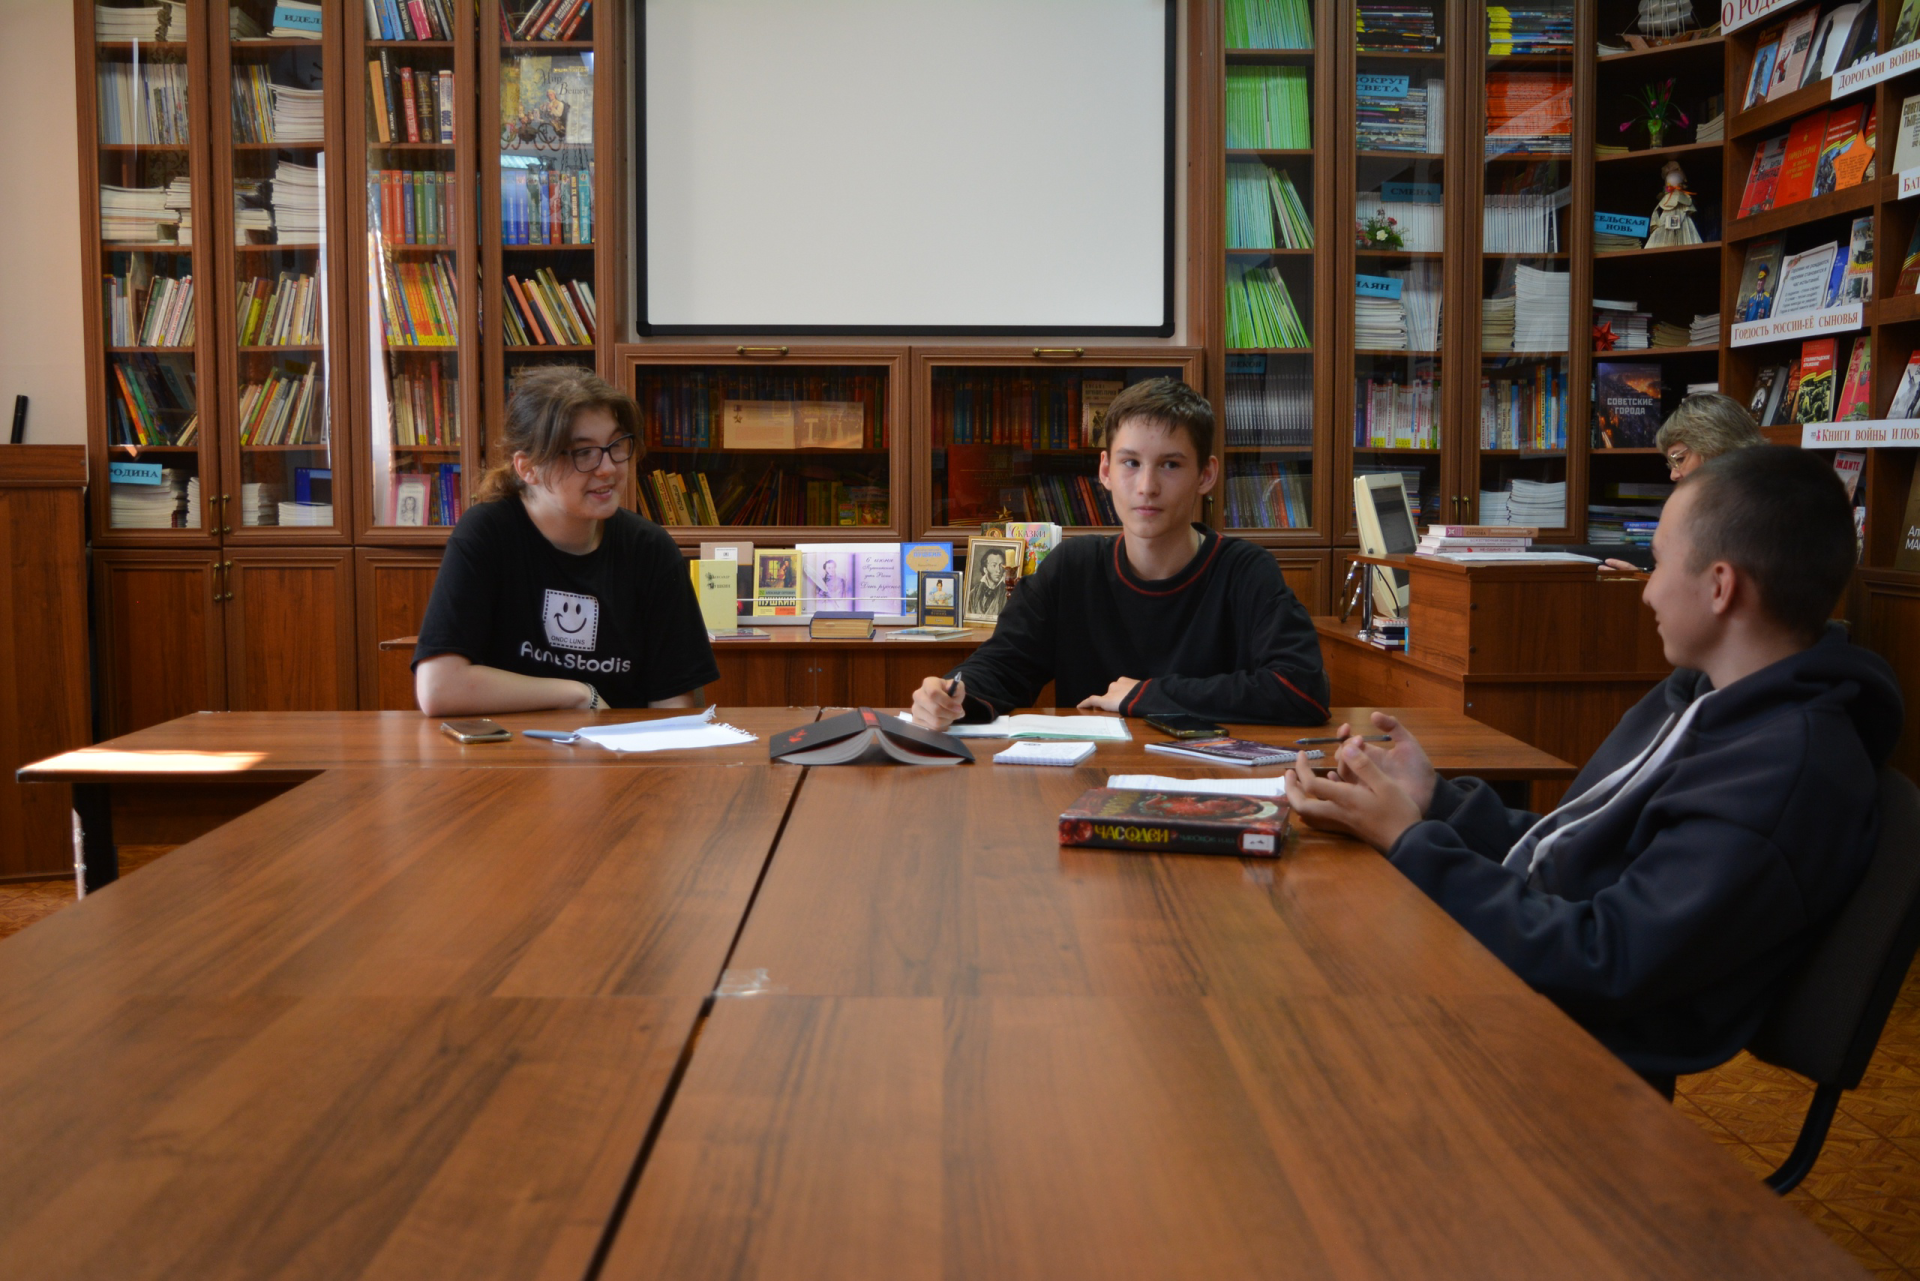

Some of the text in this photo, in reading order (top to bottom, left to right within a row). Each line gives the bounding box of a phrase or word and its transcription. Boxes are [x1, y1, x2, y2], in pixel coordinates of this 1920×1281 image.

[283, 14, 322, 25] ИДЕЛ
[1722, 2, 1734, 27] О
[1838, 62, 1885, 91] ДОРОГАМИ
[1390, 187, 1432, 197] СМЕНА
[1594, 214, 1646, 227] СЕЛЬСКАЯ
[1606, 224, 1633, 233] НОВЬ
[1734, 326, 1769, 341] ГОРДОСТЬ
[1818, 311, 1858, 329] СЫНОВЬЯ
[1606, 397, 1653, 406] СОВЕТСКИЕ
[1614, 407, 1646, 416] ГОРОДА
[1821, 428, 1850, 442] КНИГИ
[1855, 426, 1887, 441] ВОЙНЫ
[1892, 428, 1899, 440] И
[1905, 538, 1920, 550] МА
[758, 596, 796, 606] ПУШКИН
